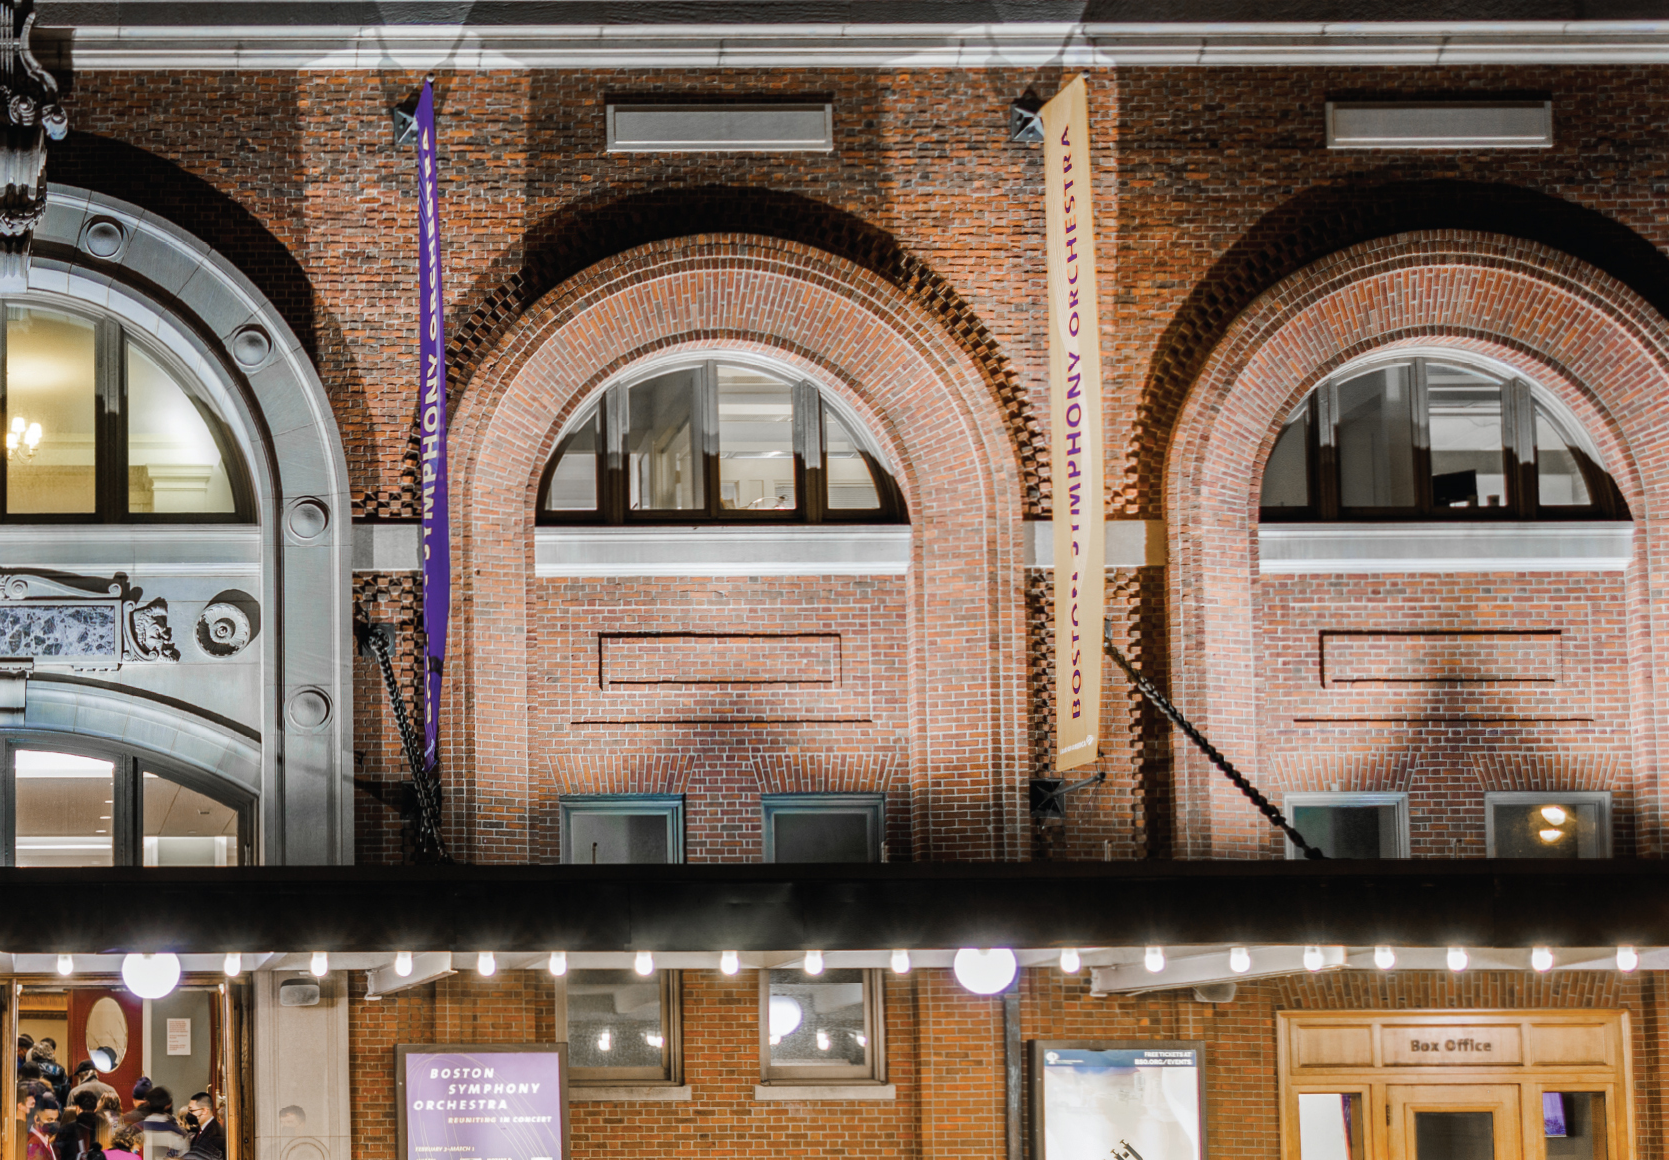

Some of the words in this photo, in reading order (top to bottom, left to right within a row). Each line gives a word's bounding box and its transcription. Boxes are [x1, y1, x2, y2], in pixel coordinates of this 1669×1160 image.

[421, 126, 438, 342] ORCHESTRA
[1060, 123, 1080, 338] ORCHESTRA
[1410, 1039, 1439, 1052] Box
[1444, 1038, 1492, 1052] Office
[430, 1068, 494, 1079] BOSTON
[448, 1083, 540, 1095] SYMPHONY
[413, 1100, 508, 1111] ORCHESTRA
